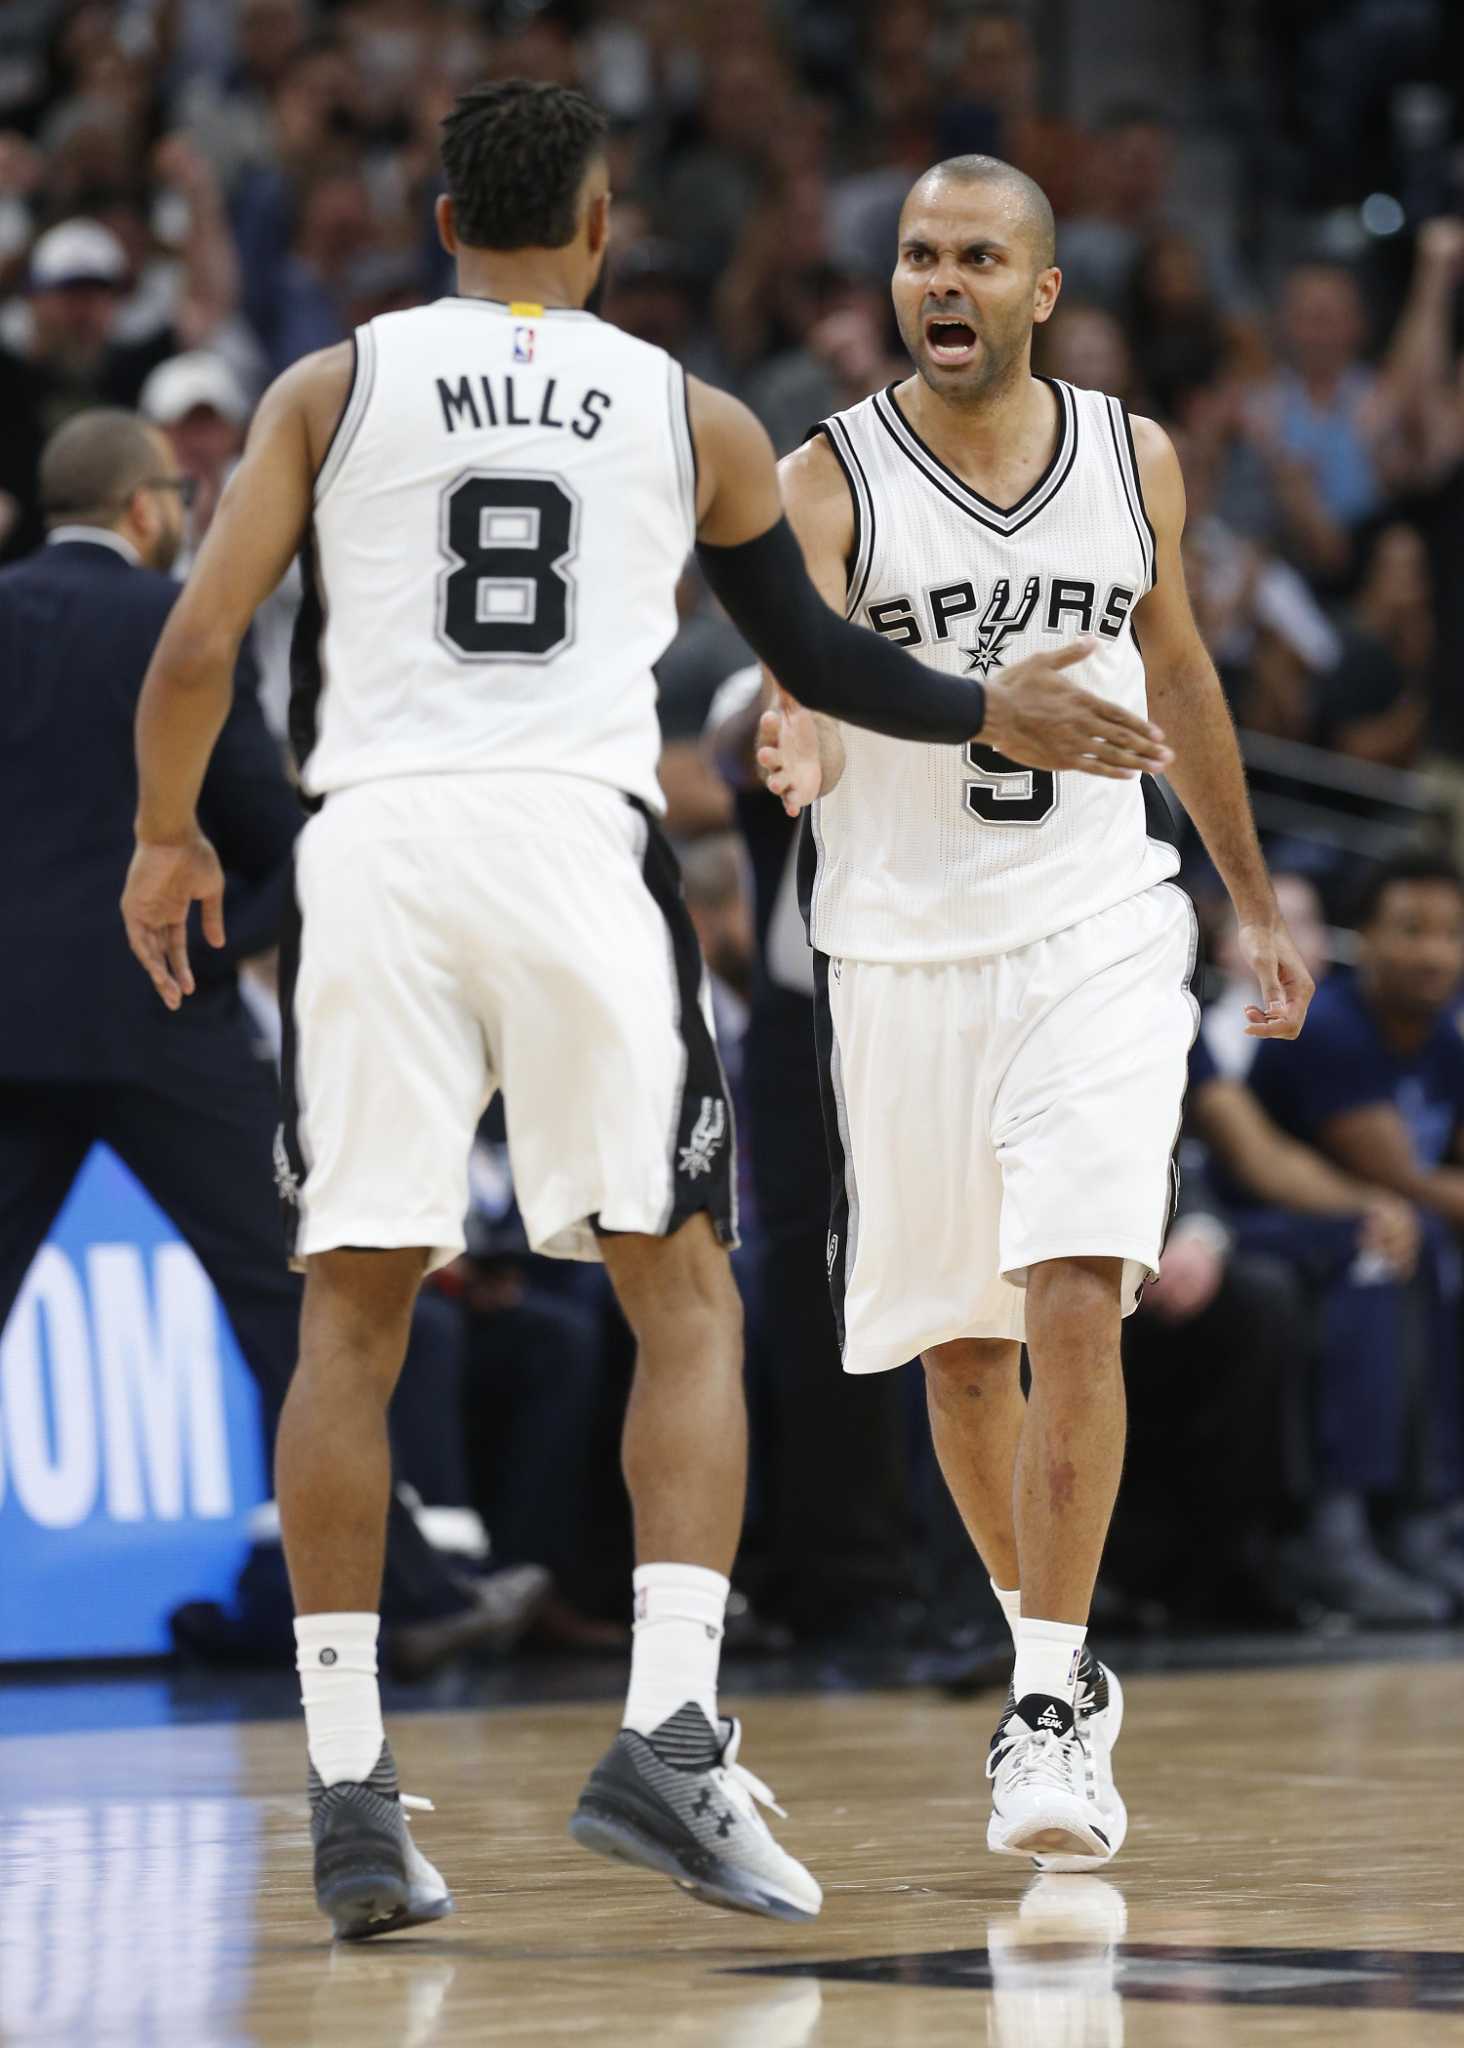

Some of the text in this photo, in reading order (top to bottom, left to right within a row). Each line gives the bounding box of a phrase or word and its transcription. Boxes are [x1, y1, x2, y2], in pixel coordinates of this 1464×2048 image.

[436, 375, 611, 440] MILLS
[434, 467, 582, 664] 8
[866, 574, 1135, 678] SPURS
[0, 1242, 234, 1530] OM
[1037, 1717, 1063, 1729] PEAK
